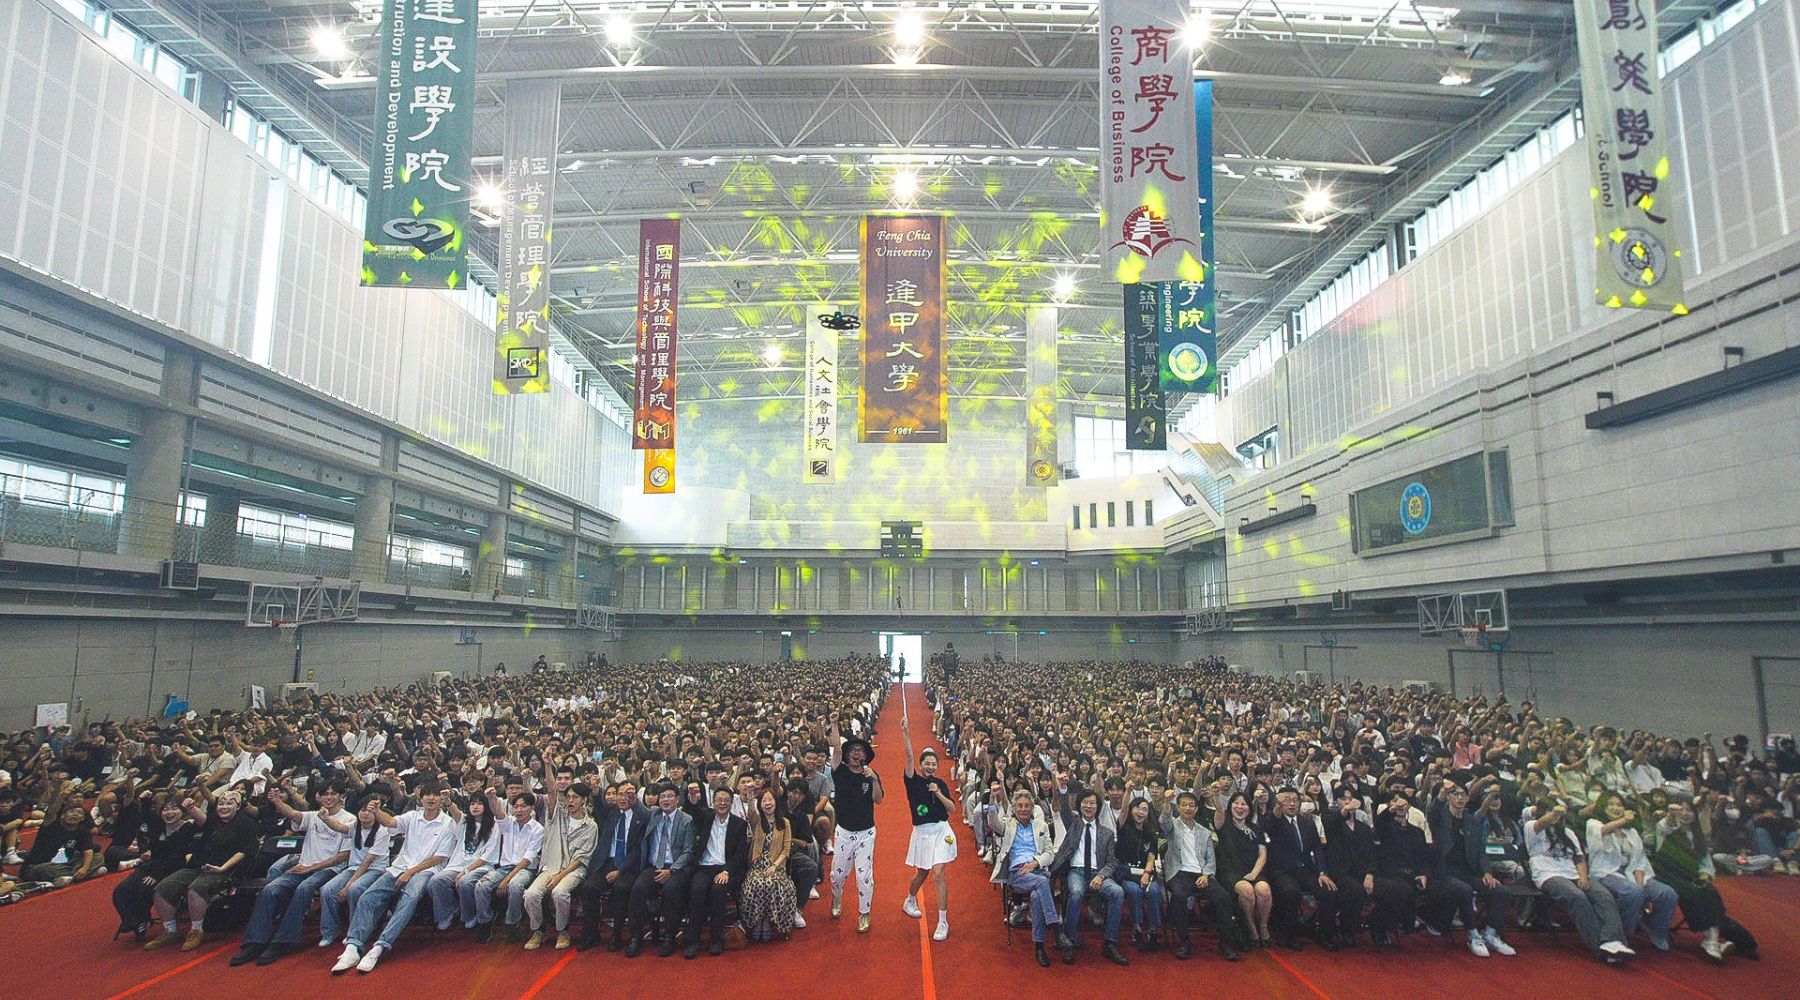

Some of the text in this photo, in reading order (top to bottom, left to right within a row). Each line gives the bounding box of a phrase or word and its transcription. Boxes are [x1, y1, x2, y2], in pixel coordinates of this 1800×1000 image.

[390, 60, 402, 87] and
[1109, 25, 1126, 184] College of Business
[1129, 25, 1187, 182] 商學院
[382, 92, 402, 190] Development
[875, 246, 933, 260] University
[876, 229, 932, 244] Feng Chia
[649, 244, 674, 410] 國際科技與管理學院
[883, 279, 925, 392] 逢甲大學
[1137, 282, 1164, 410] 築專業學院
[893, 426, 913, 435] 1961
